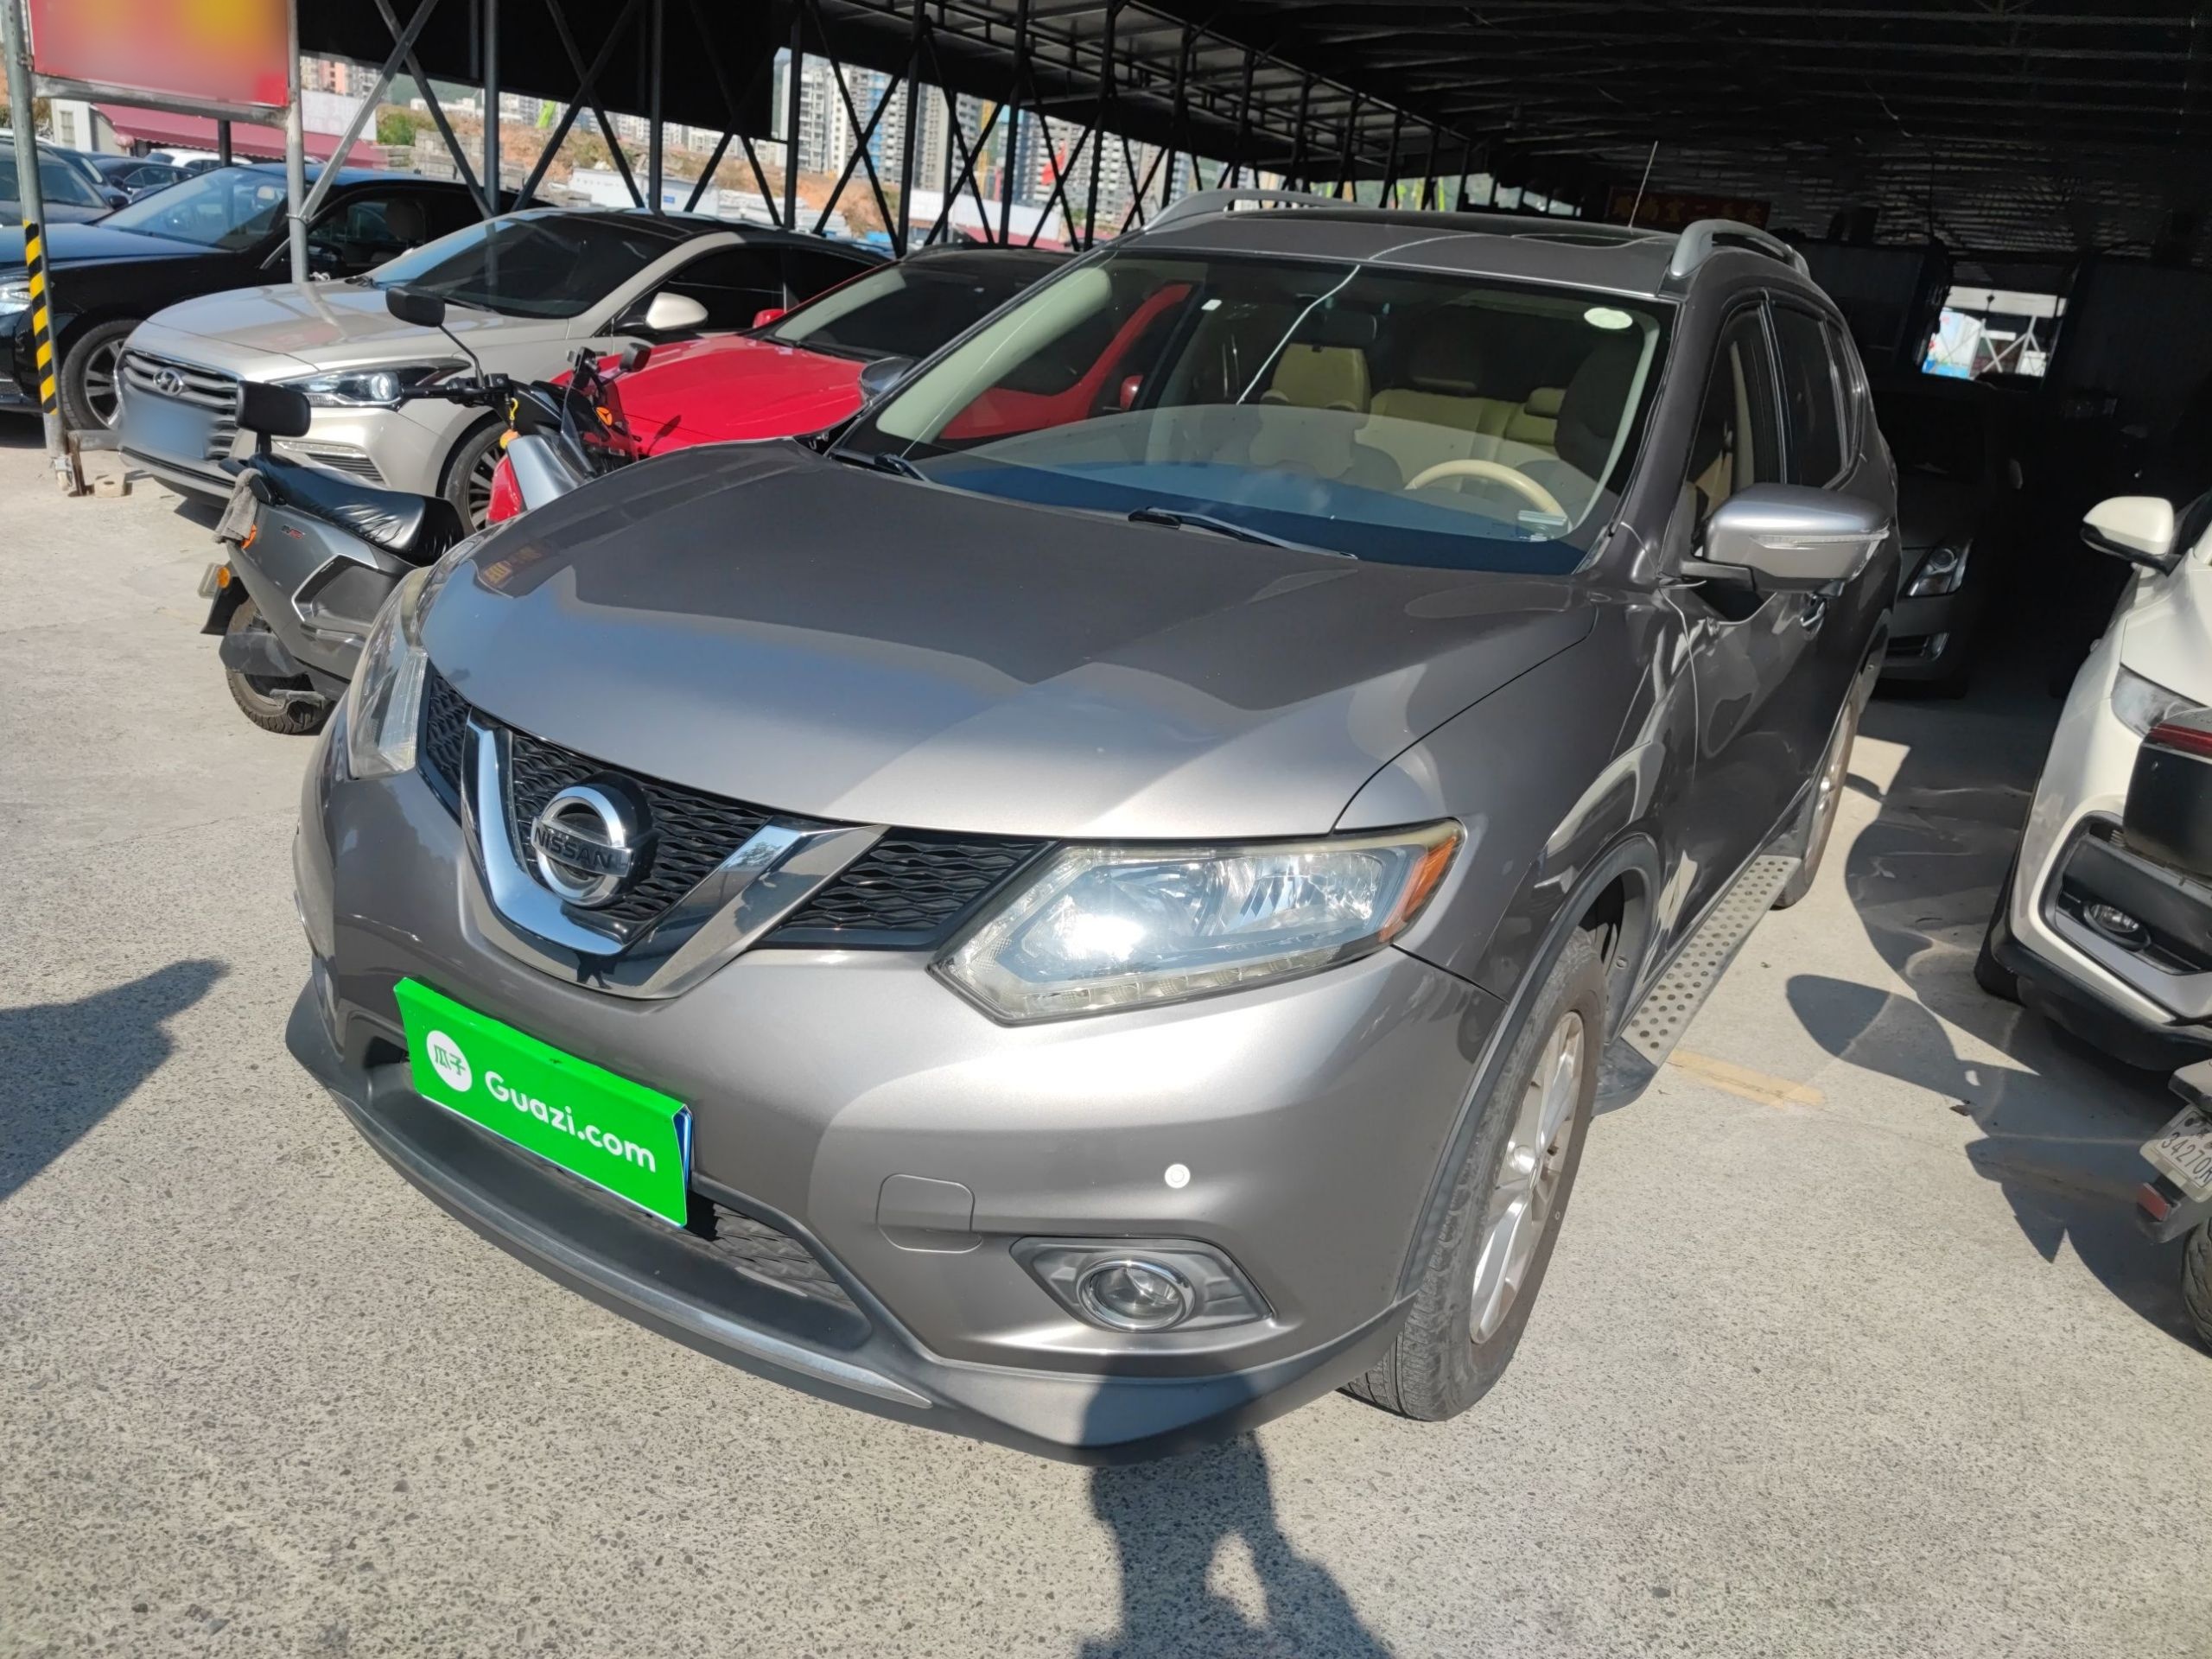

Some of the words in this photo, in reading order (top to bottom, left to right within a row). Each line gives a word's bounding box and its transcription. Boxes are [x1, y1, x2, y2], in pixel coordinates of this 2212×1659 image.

[533, 826, 613, 869] NISSAN
[433, 1044, 466, 1077] 瓜子
[484, 1071, 657, 1173] Guazi.com
